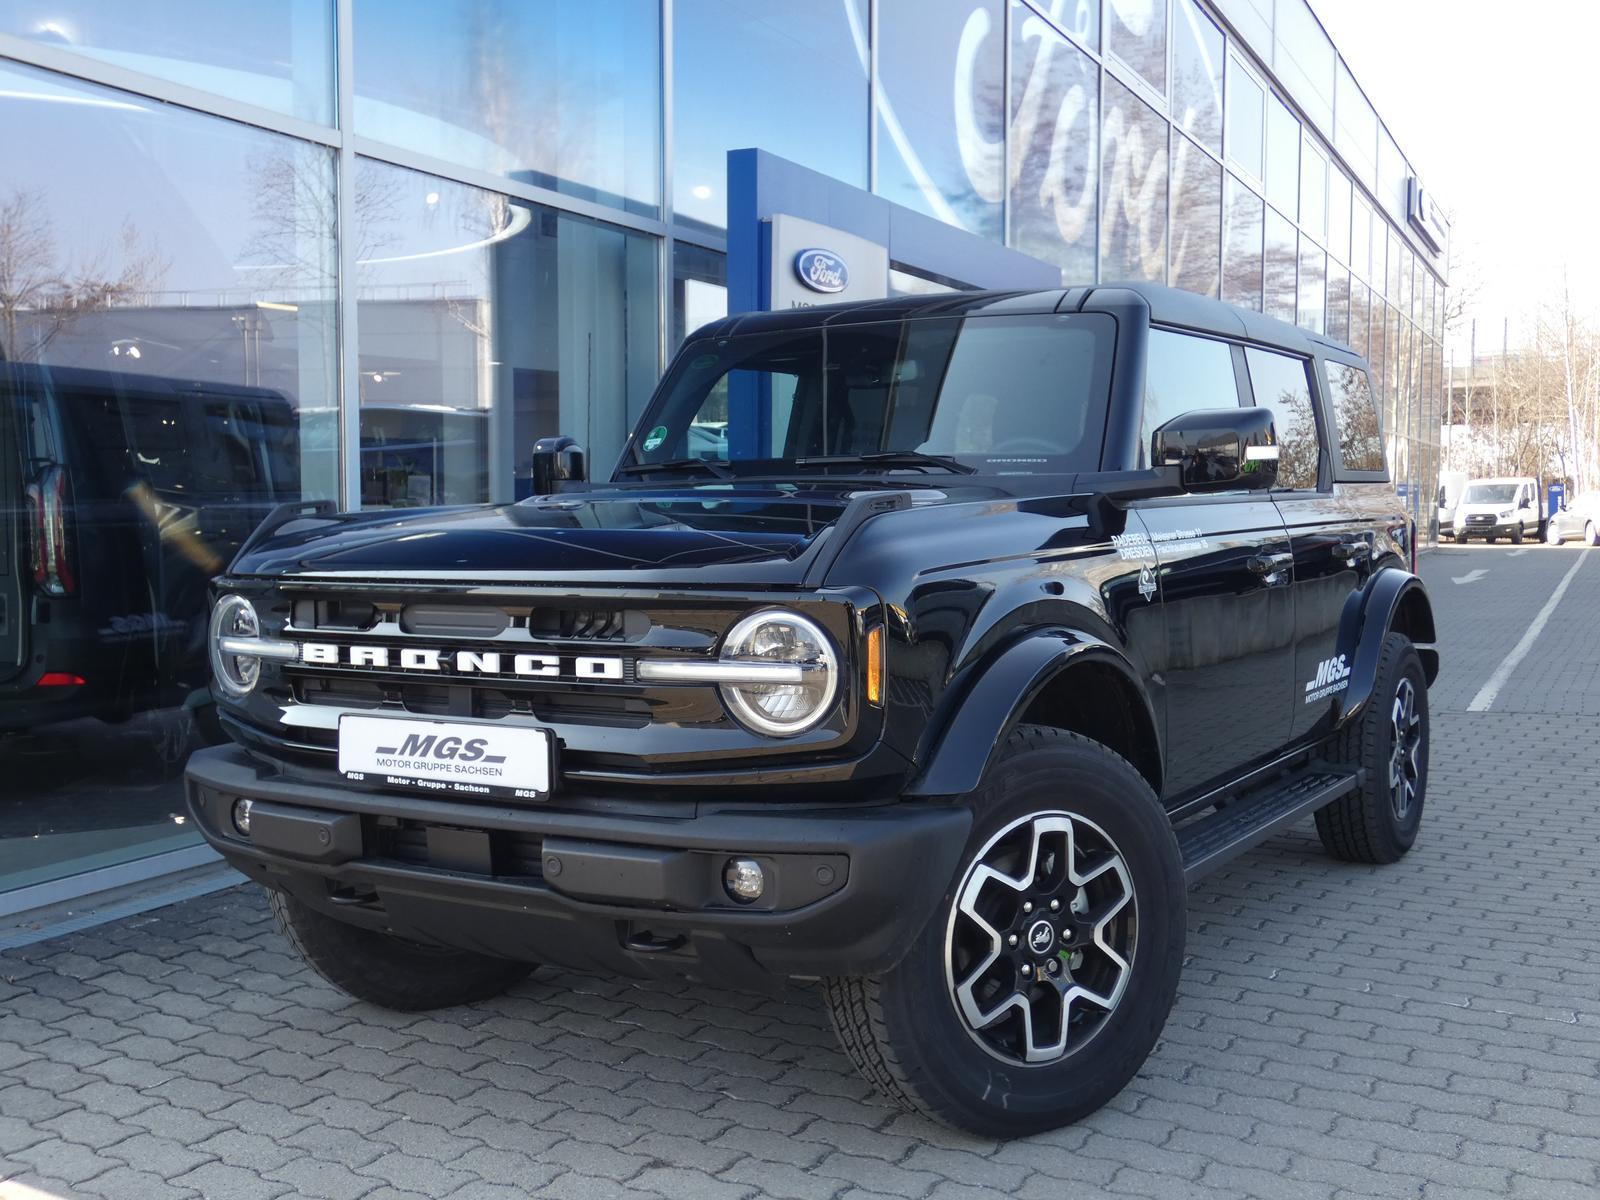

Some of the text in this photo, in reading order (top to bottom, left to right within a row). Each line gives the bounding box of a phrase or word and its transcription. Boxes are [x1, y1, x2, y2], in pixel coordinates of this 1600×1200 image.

[809, 255, 841, 286] Ford
[302, 642, 624, 680] BRONCO
[1314, 654, 1346, 688] MGS
[398, 733, 489, 762] MGS
[346, 772, 364, 781] MGS
[376, 758, 503, 777] MOTOR GRUPPE SACHSEN
[387, 775, 410, 785] Motor
[417, 779, 446, 790] Gruppe
[454, 783, 490, 794] Sachsen
[514, 789, 536, 798] MGS
